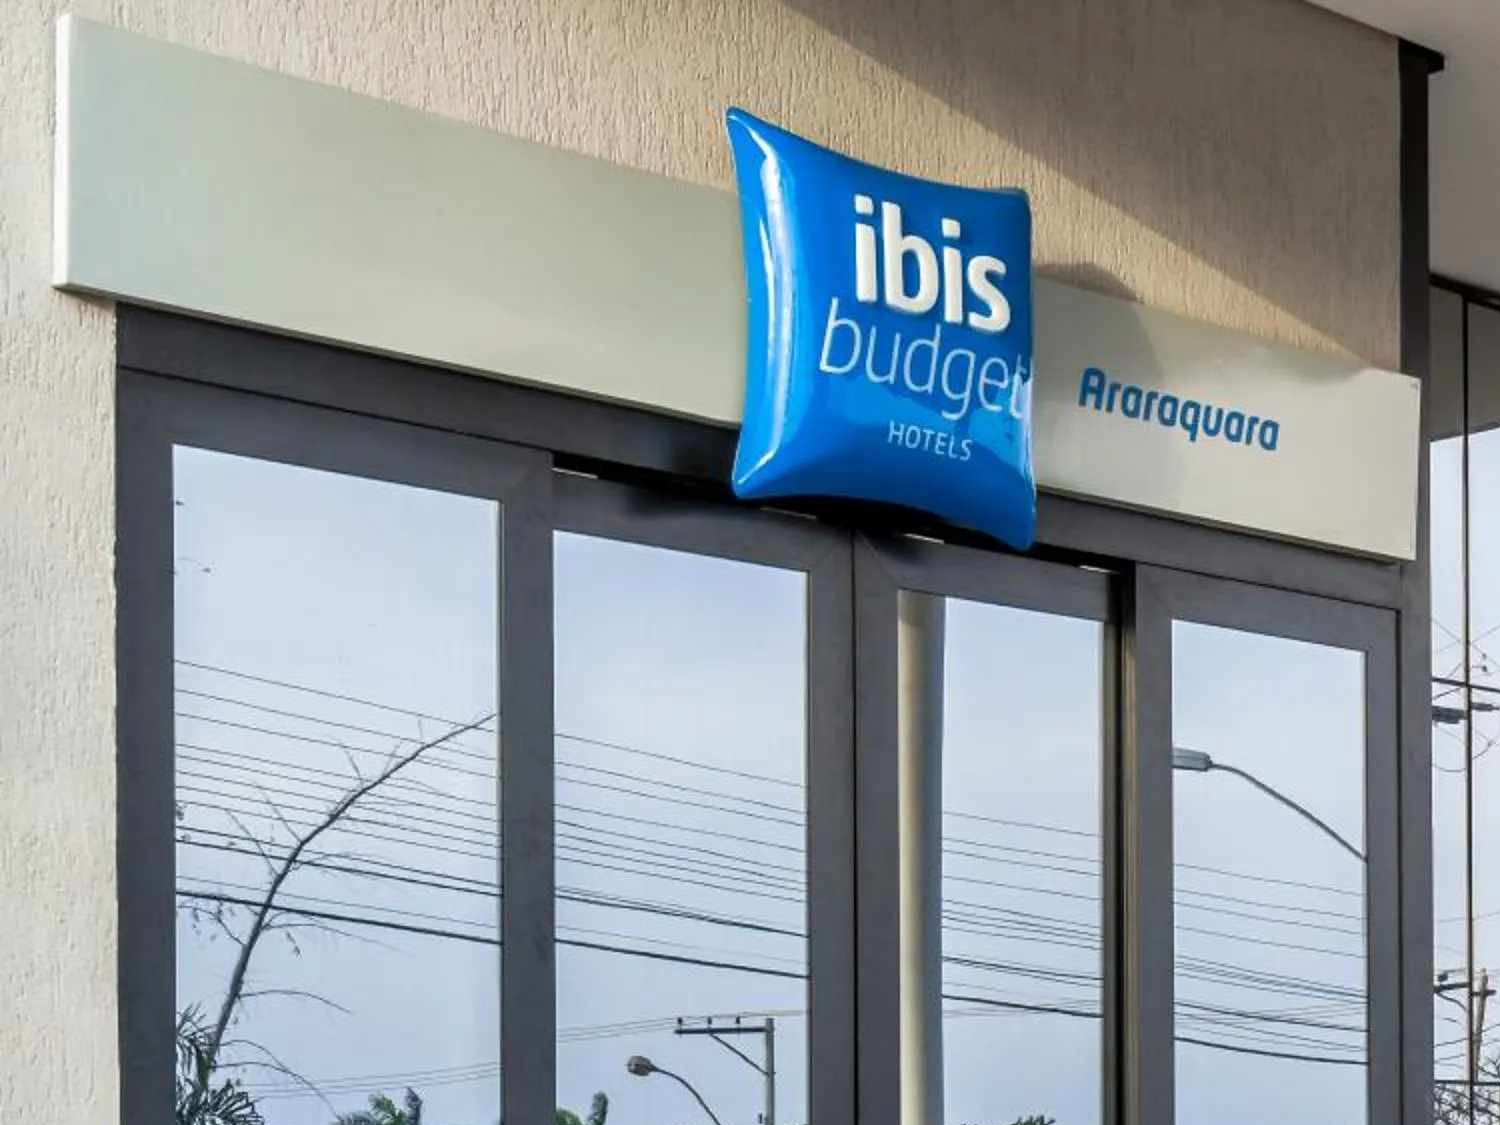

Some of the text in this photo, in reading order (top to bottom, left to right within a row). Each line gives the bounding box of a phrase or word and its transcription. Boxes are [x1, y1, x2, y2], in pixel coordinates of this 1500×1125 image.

[854, 195, 1011, 332] ibis
[819, 297, 1027, 421] budget
[1078, 367, 1280, 451] Araraquara
[887, 421, 973, 461] HOTELS
